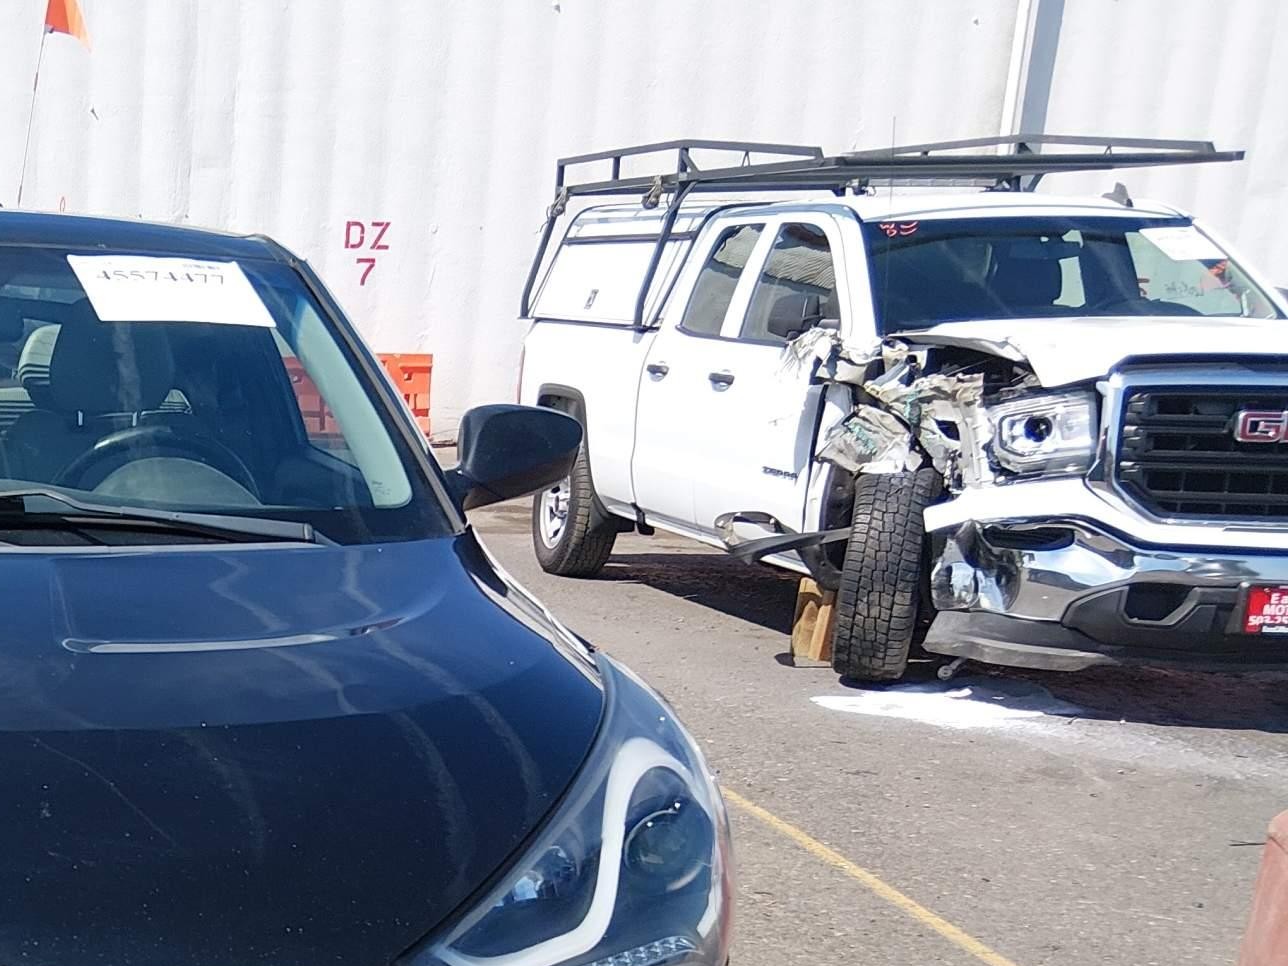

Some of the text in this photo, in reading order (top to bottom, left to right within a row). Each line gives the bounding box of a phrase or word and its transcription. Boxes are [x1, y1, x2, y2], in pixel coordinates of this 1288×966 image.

[344, 221, 391, 250] DZ
[356, 258, 376, 286] 7
[1235, 410, 1288, 443] G
